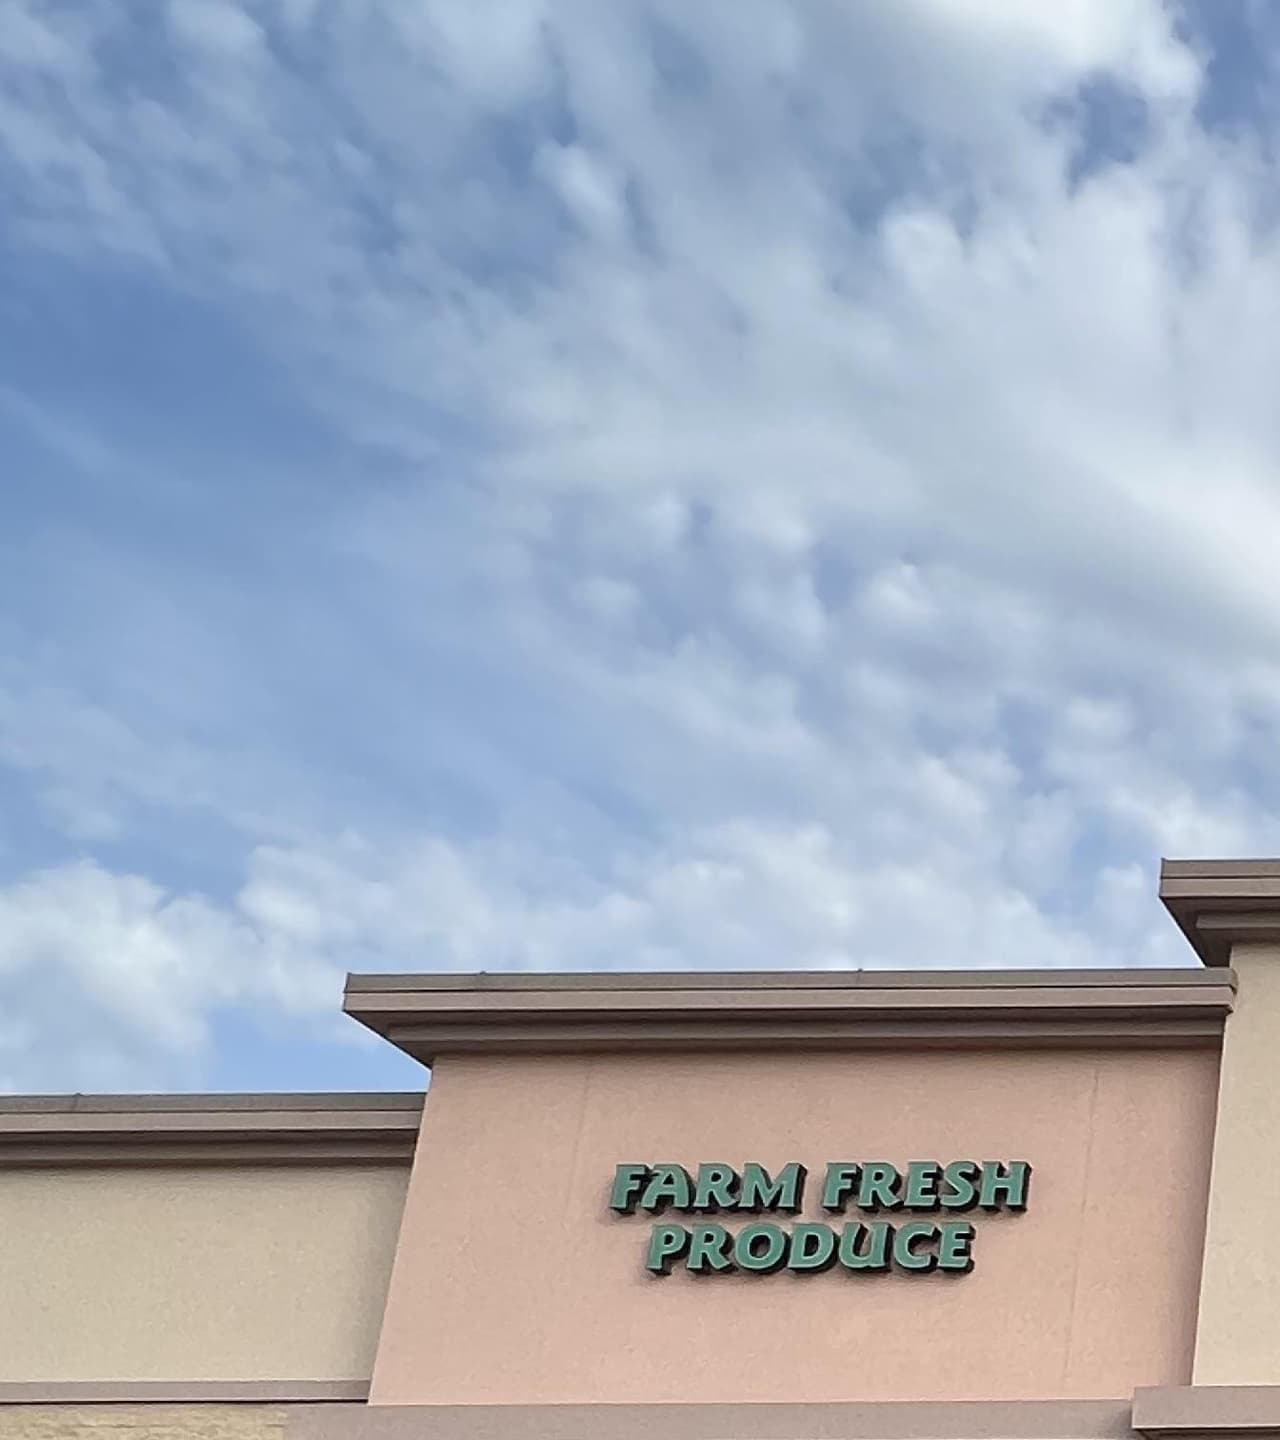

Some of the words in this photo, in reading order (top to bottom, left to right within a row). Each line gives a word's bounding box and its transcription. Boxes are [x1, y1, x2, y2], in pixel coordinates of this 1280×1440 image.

[608, 1162, 807, 1213] FARM
[821, 1160, 1032, 1212] FRESH
[645, 1221, 976, 1275] PRODUCE
